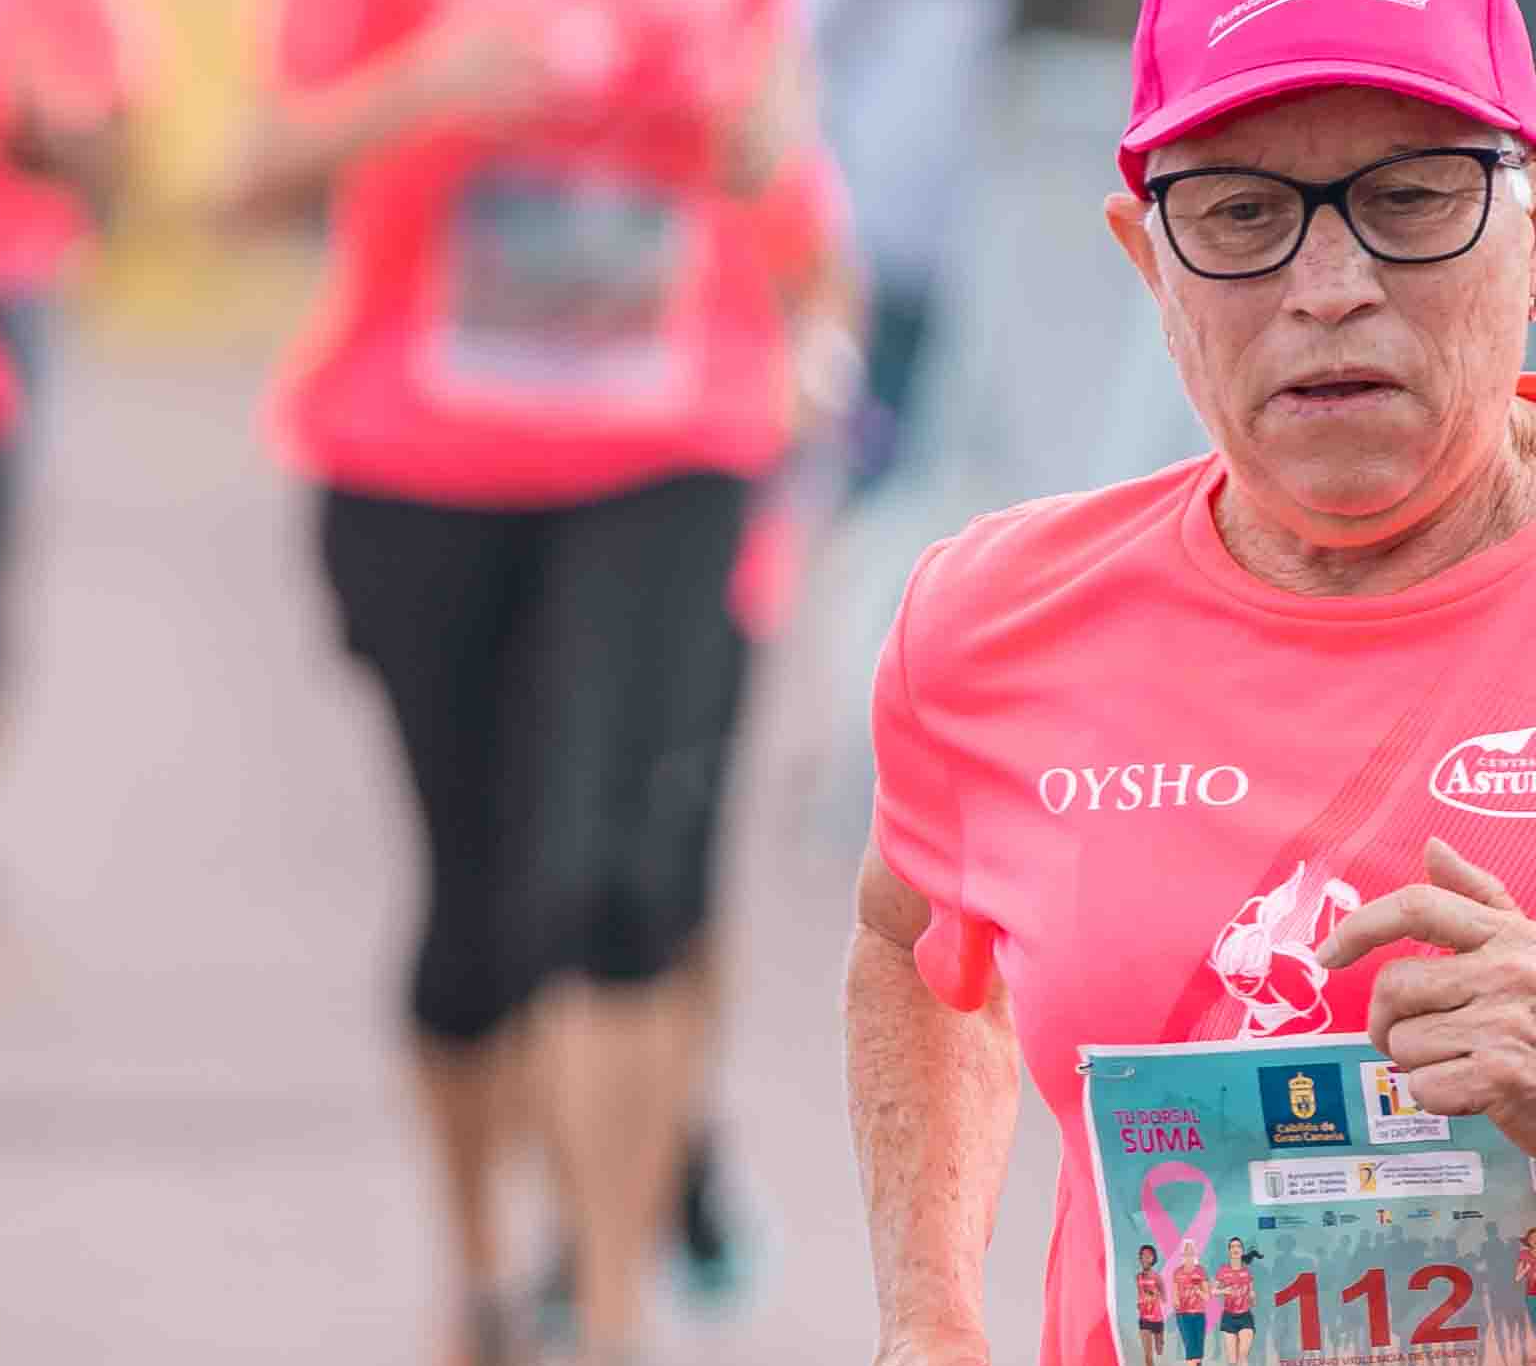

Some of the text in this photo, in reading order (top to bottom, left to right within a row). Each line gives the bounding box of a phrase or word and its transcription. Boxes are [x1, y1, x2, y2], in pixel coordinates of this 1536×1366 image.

[1039, 763, 1249, 813] OYSHO
[1120, 1127, 1206, 1154] SUMA
[1274, 1264, 1480, 1352] 112
